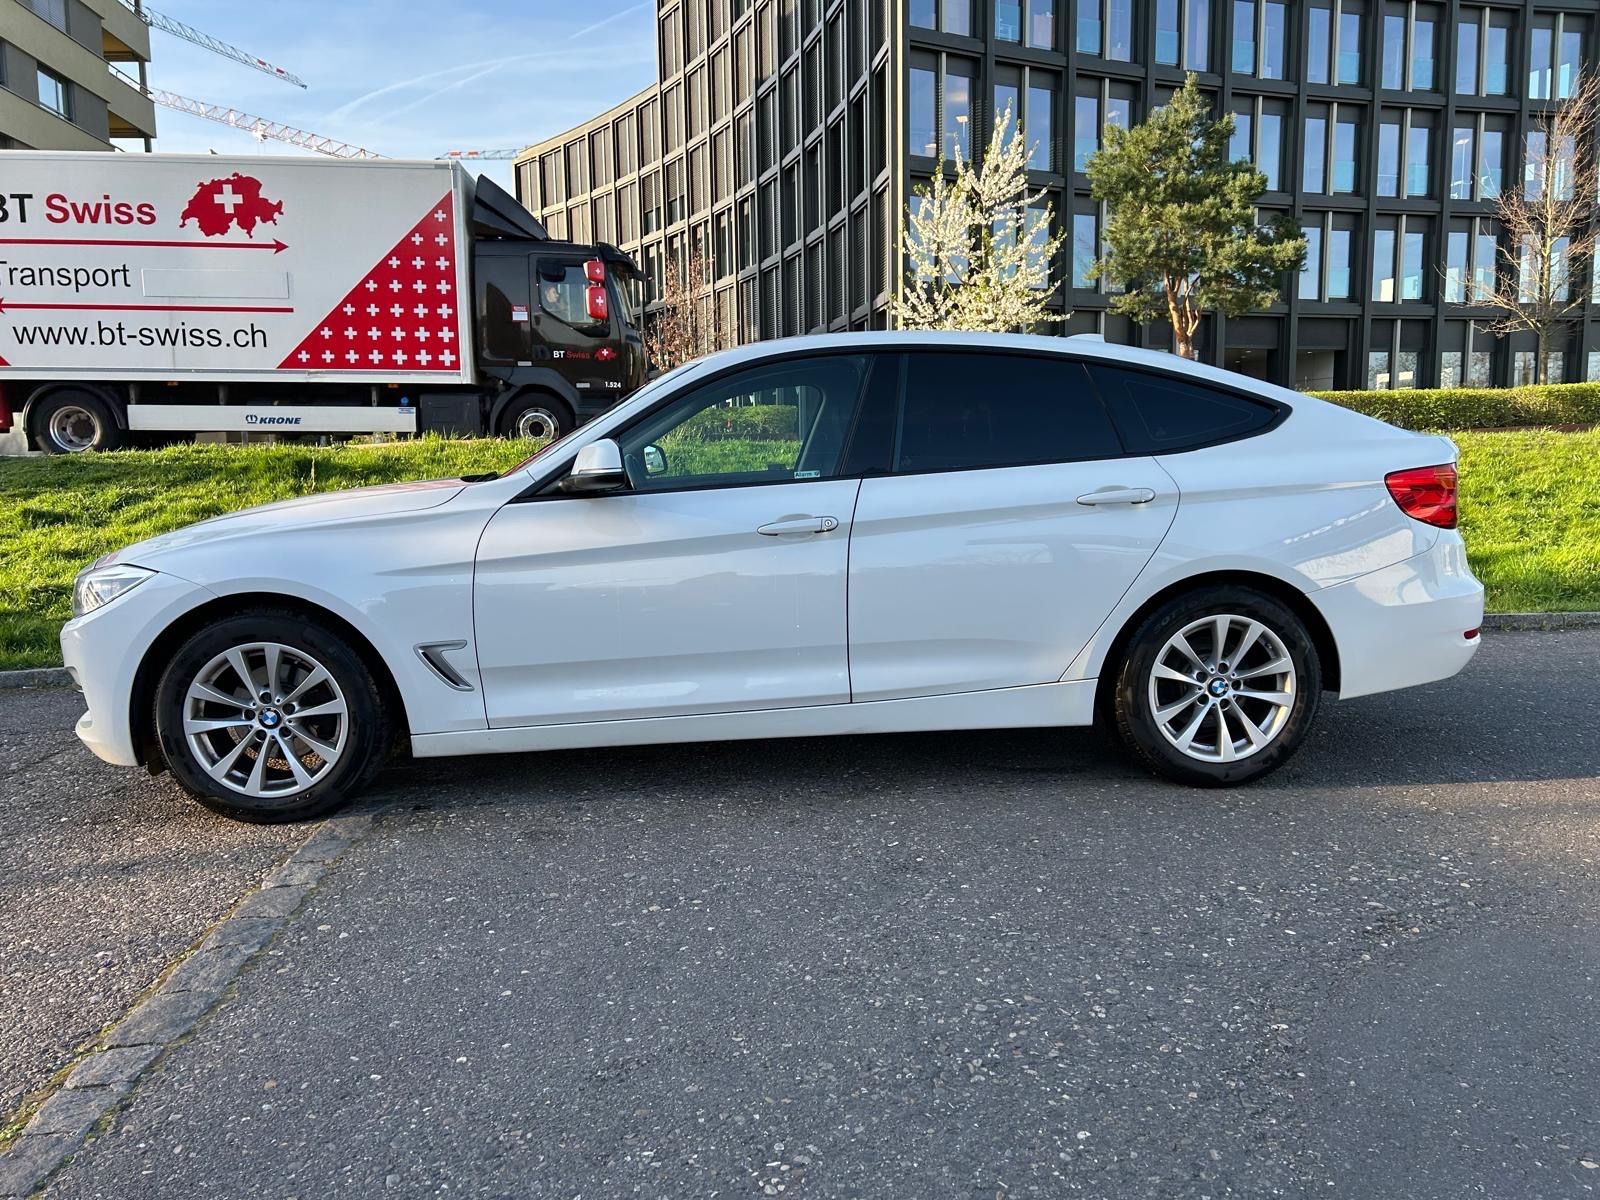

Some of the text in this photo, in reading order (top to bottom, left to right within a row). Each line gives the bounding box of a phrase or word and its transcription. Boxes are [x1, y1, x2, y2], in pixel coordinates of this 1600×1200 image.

[45, 193, 157, 225] Swiss
[13, 320, 268, 348] www.bt-swiss.ch
[553, 350, 591, 360] BT Swiss
[604, 381, 622, 389] 1.524
[259, 416, 301, 425] KRONE
